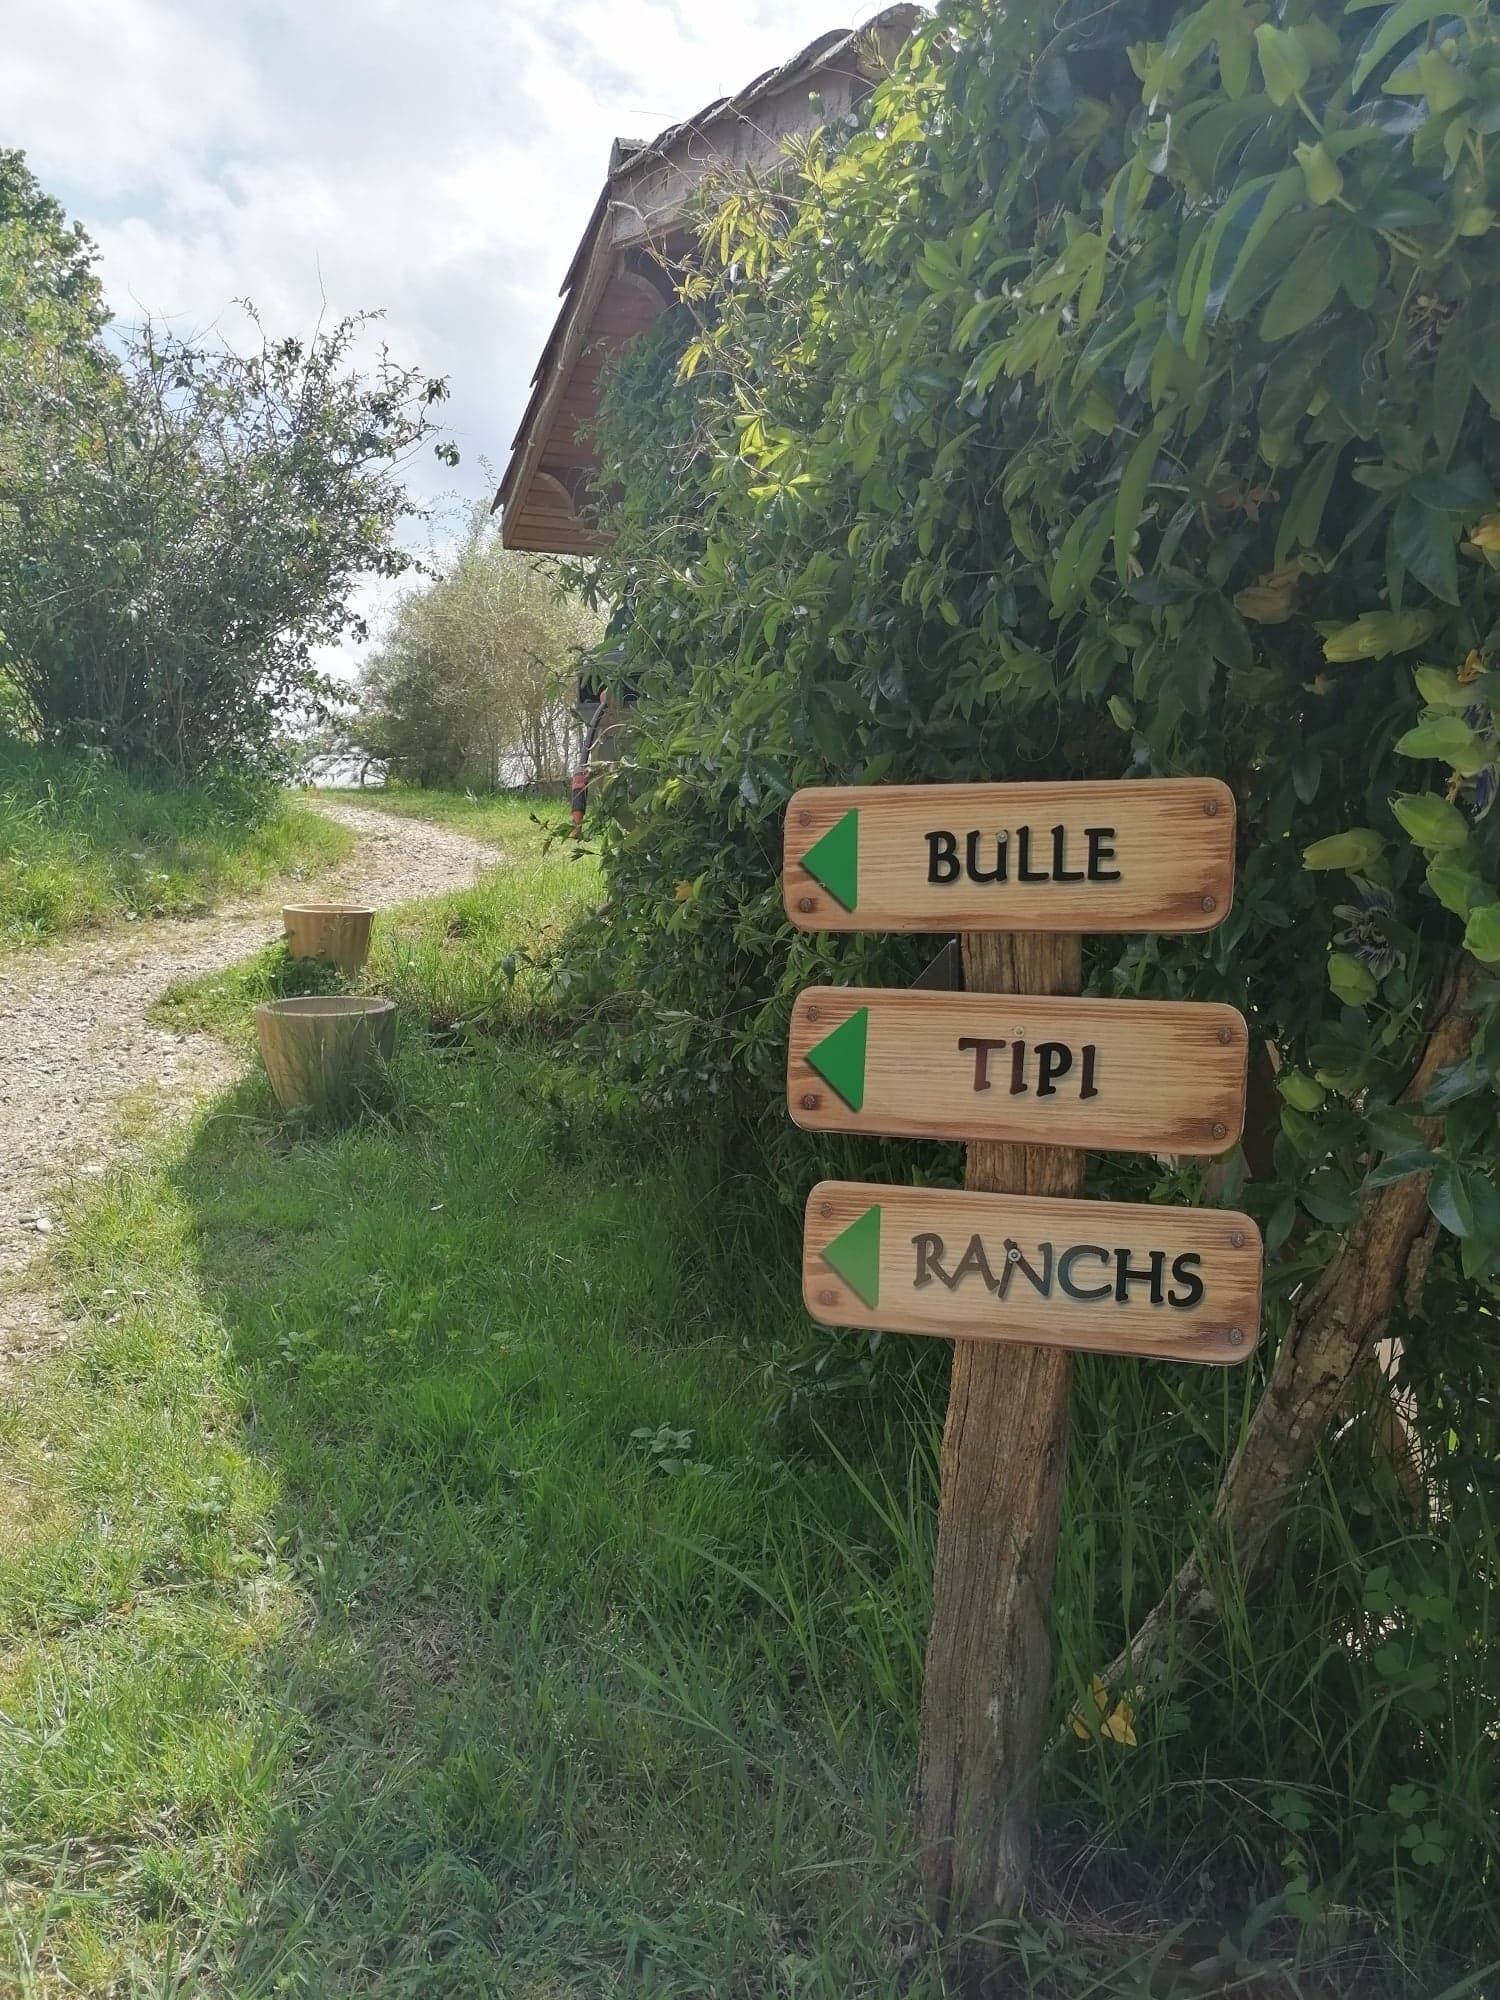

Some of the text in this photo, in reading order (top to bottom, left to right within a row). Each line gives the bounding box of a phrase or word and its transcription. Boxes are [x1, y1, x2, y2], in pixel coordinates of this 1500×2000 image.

[924, 824, 1121, 883] BULLE
[958, 1037, 1098, 1099] TIPI
[911, 1232, 1204, 1307] RANCHS
